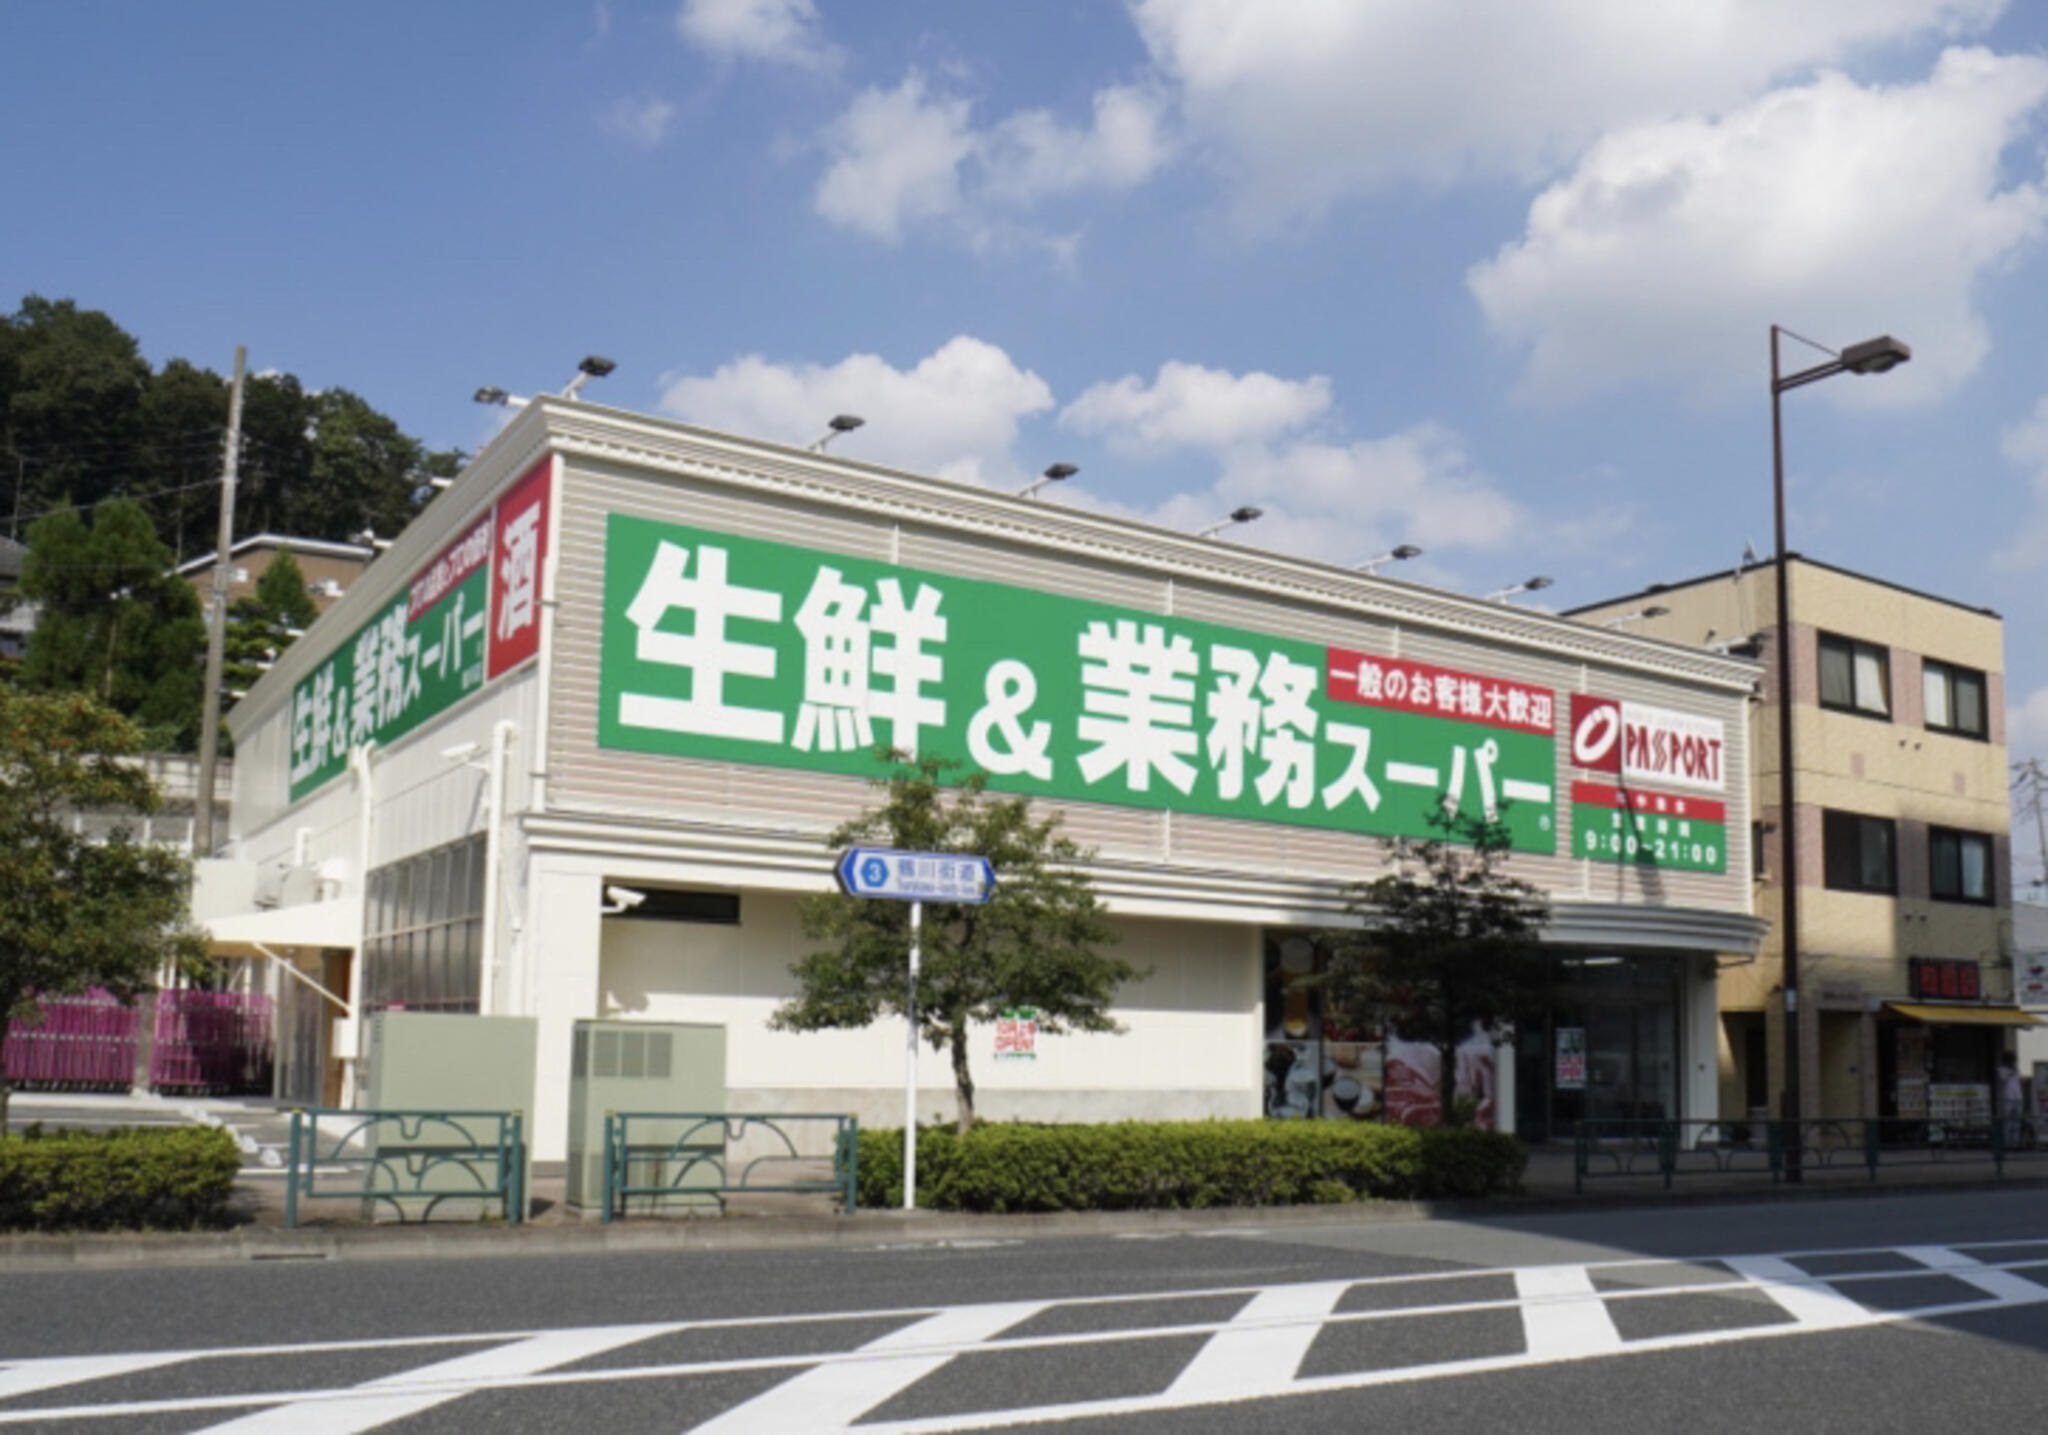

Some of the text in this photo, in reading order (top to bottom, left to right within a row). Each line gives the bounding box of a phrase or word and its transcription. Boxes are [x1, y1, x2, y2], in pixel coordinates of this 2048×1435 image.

[497, 501, 541, 641] 酒
[1328, 661, 1552, 729] 一般のお客様大歓迎
[1625, 722, 1722, 781] PASSPORT
[868, 863, 882, 883] 3
